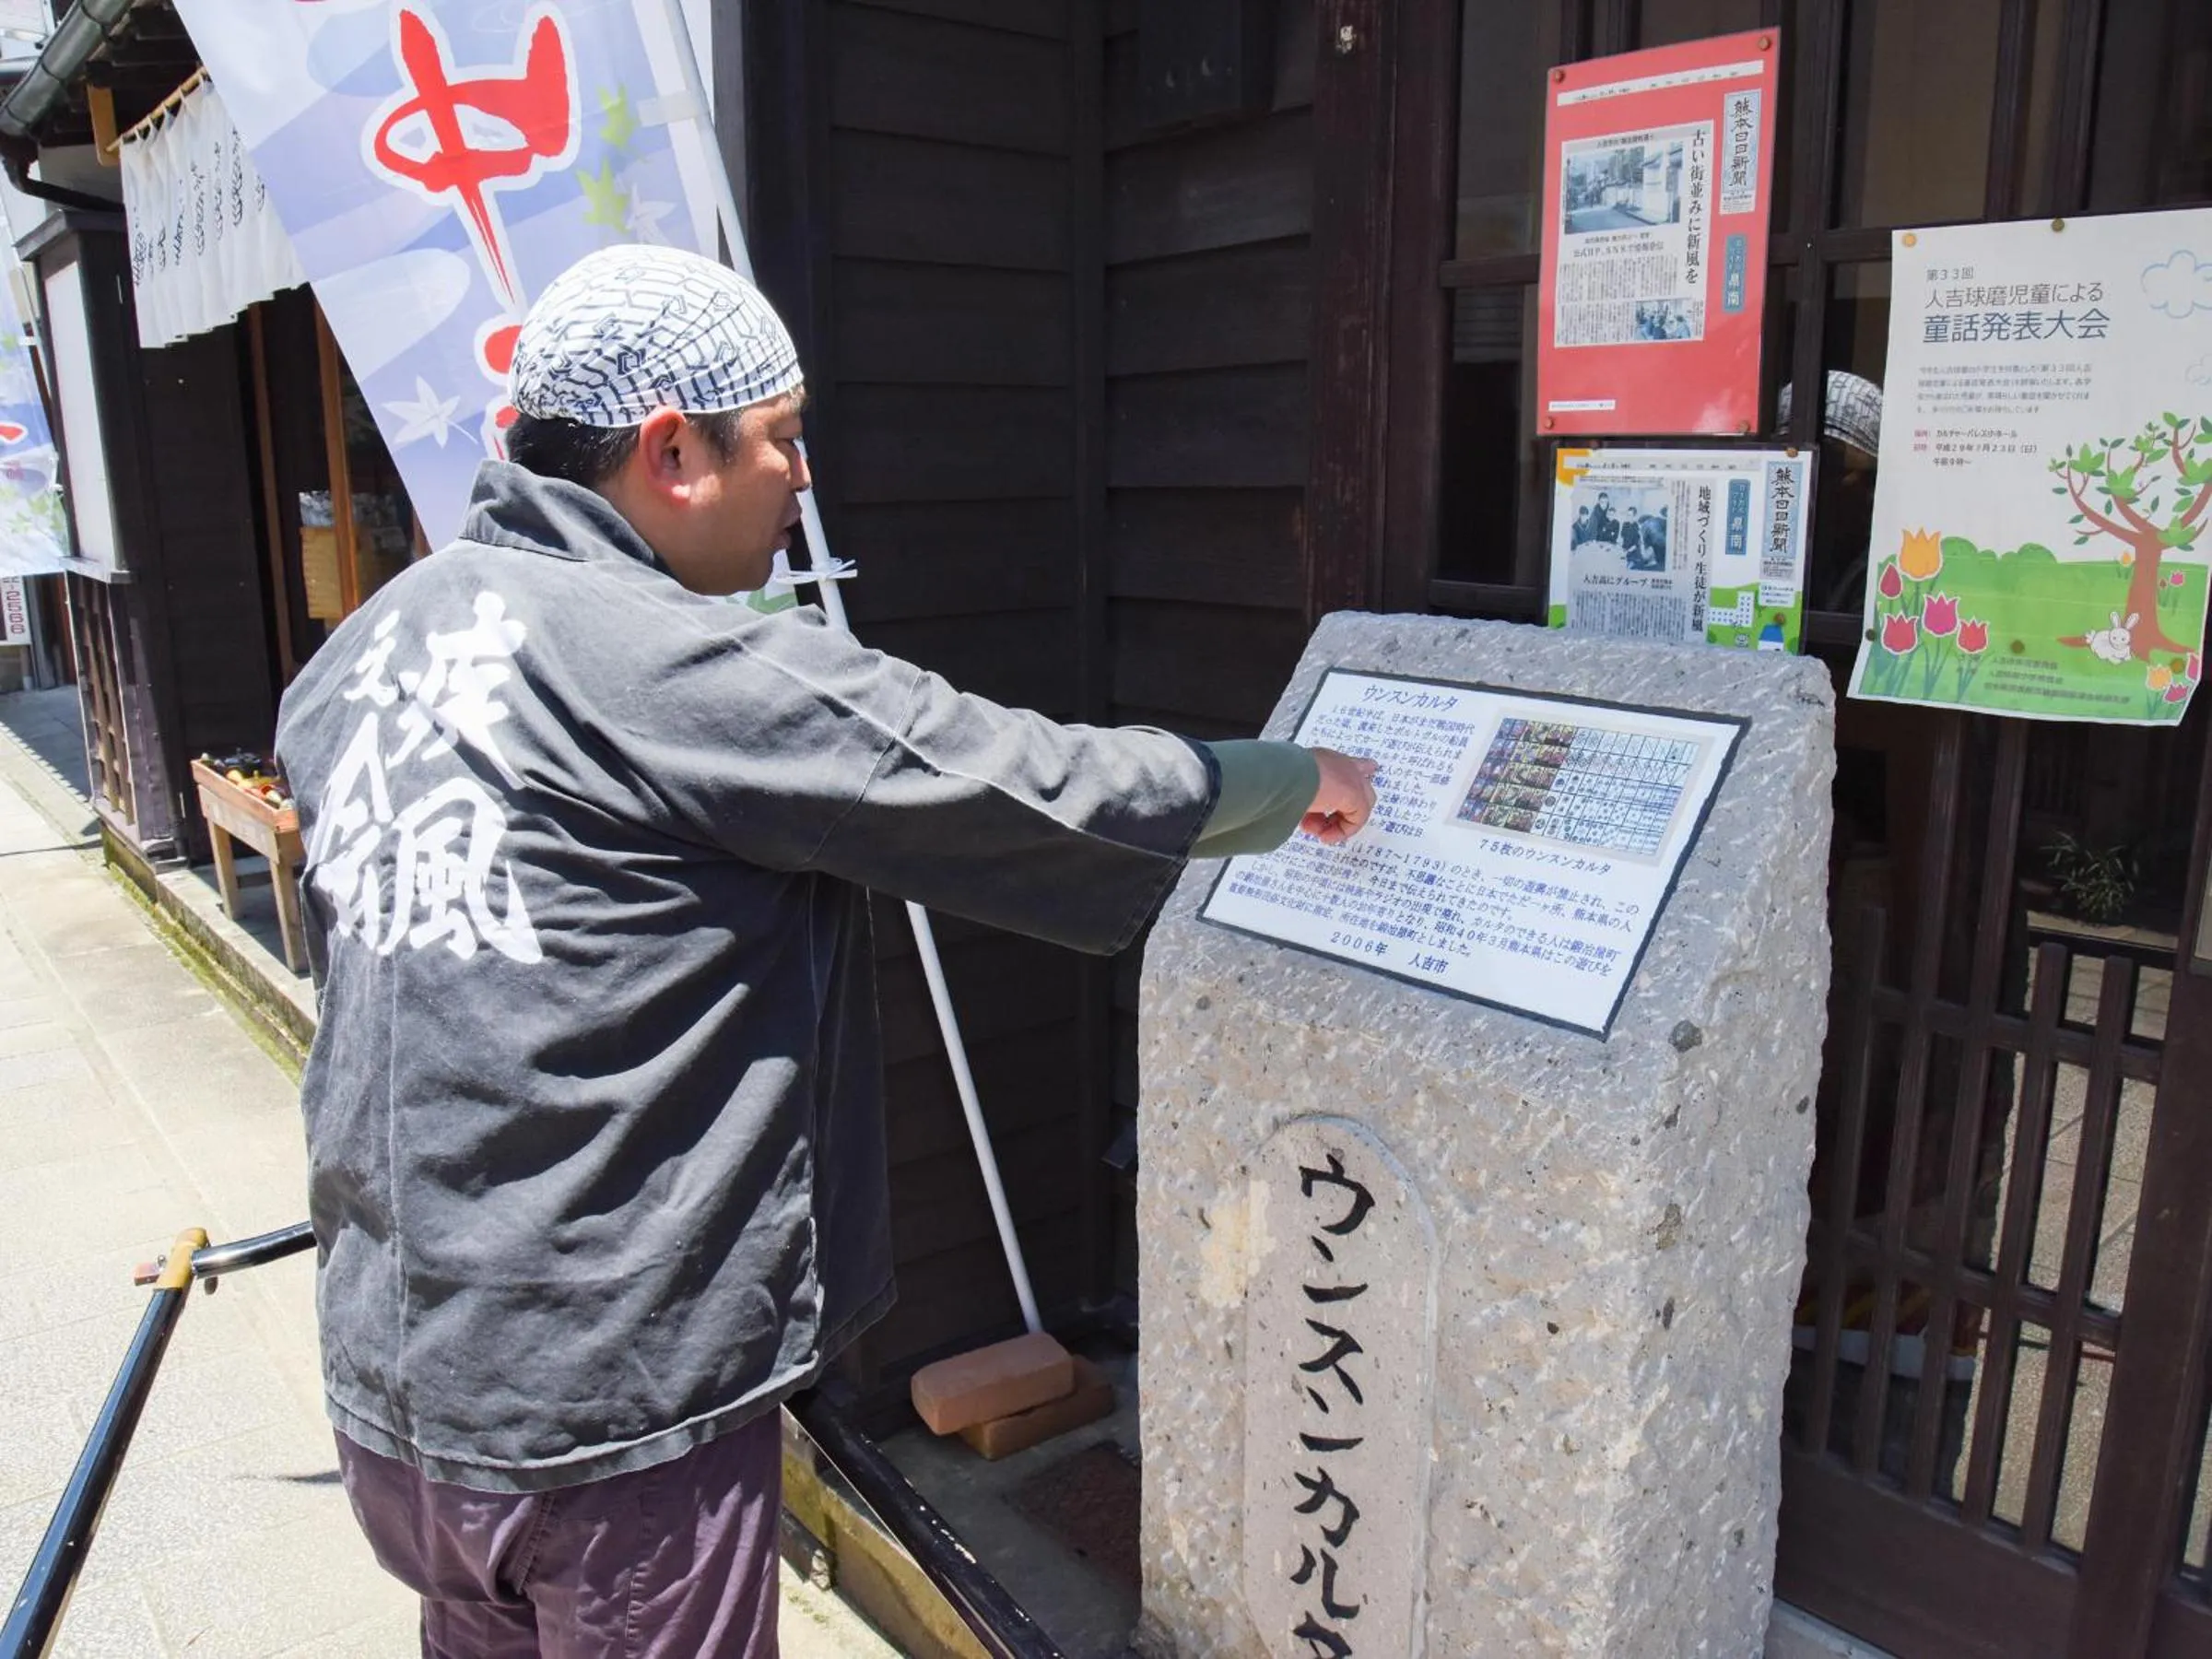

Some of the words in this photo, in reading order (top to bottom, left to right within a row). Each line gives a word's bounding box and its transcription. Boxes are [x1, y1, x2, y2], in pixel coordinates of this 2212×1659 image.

[1730, 99, 1753, 187] 熊本日日新聞
[1685, 129, 1706, 284] 古い街並みに新風を
[1924, 282, 2104, 309] 人吉球磨児童による
[1926, 266, 1974, 280] 第33回
[1923, 307, 2111, 344] 童話発表大会
[1695, 485, 1712, 559] 地域づくり
[1771, 467, 1795, 553] 熊本日日新聞
[1691, 562, 1707, 632] 生徒が新風
[1360, 684, 1460, 712] ウンスンカルタ
[1477, 838, 1611, 876] 75枚のウンスンカルタ
[1329, 930, 1389, 956] 2006年
[1406, 951, 1450, 974] 人吉市
[1290, 1153, 1376, 1659] ウンスンカルタ
